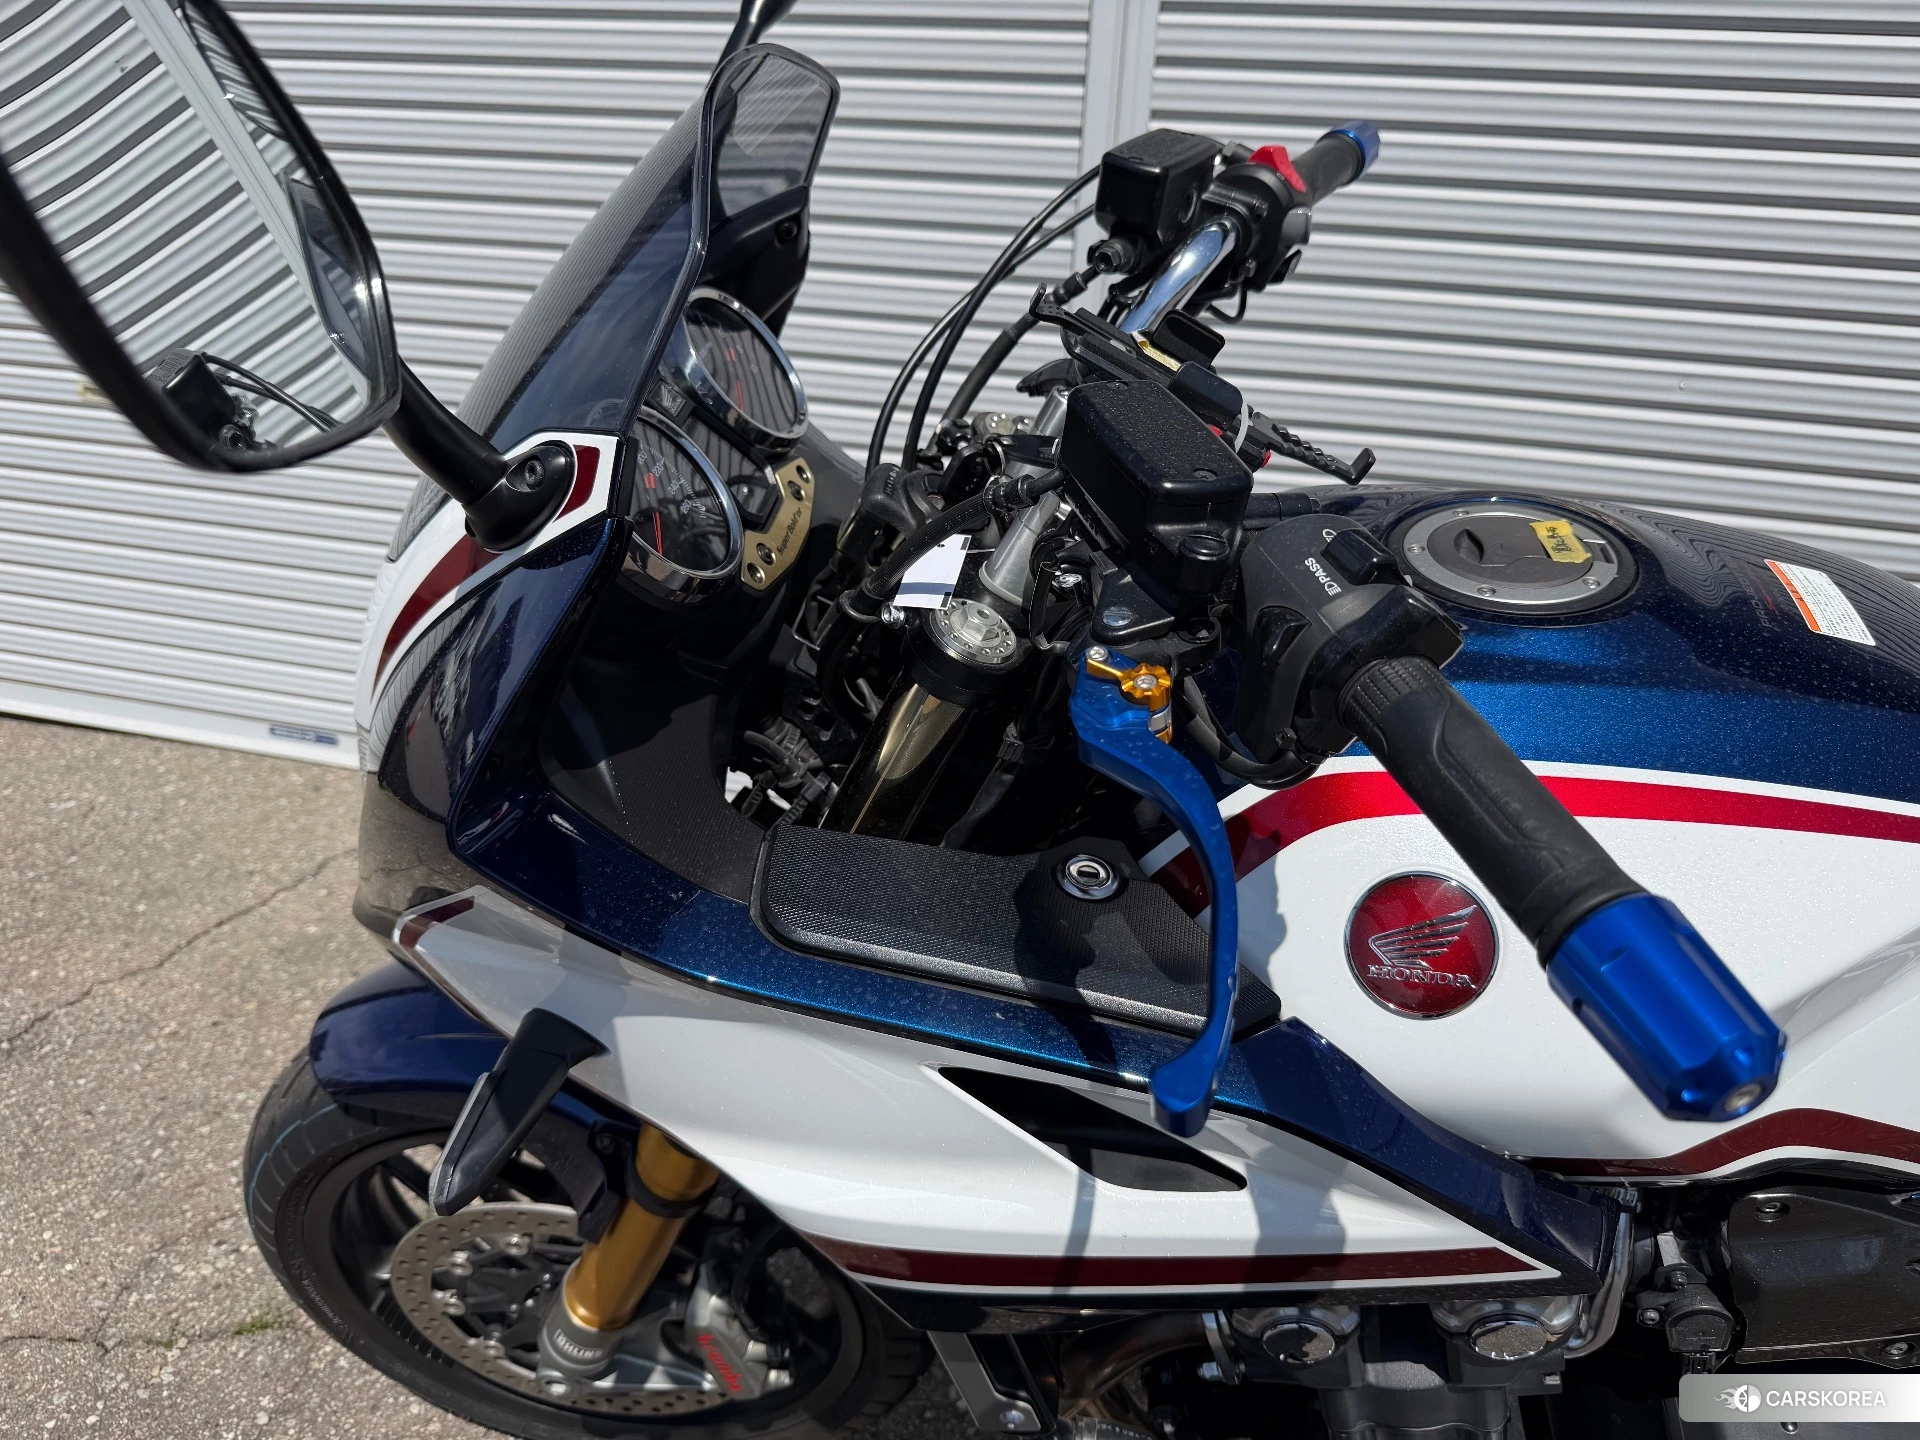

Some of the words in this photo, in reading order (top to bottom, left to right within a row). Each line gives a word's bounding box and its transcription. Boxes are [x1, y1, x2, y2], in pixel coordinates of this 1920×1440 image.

[637, 450, 648, 464] 200
[652, 462, 664, 478] 220
[668, 480, 680, 495] 240
[776, 531, 791, 557] Super
[1304, 557, 1332, 585] PASS
[1366, 964, 1477, 989] HONDA
[697, 1333, 743, 1392] brembo
